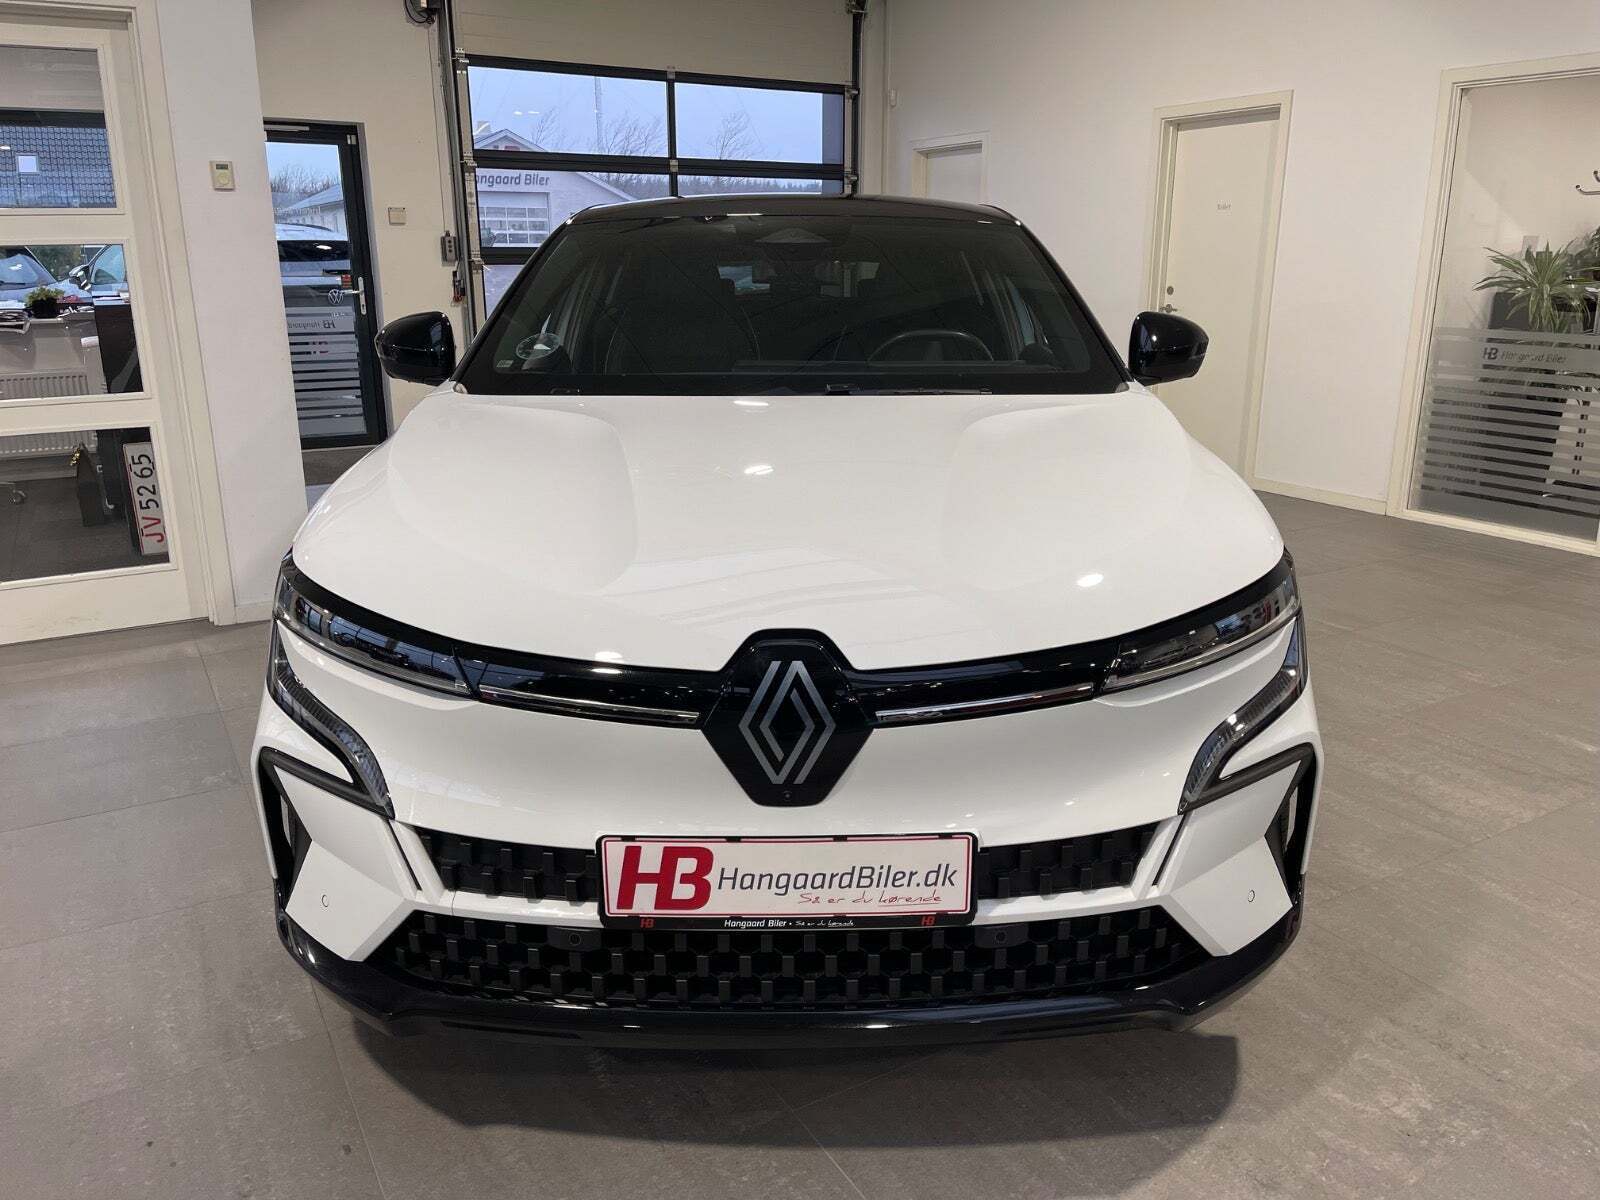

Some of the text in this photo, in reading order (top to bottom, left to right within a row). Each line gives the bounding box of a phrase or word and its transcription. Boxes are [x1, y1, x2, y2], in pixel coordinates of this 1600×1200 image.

[524, 172, 550, 186] Biler
[1483, 347, 1499, 360] HB
[141, 516, 165, 543] JV
[616, 845, 715, 911] HB
[717, 863, 957, 896] HangaardBiler.dk
[640, 918, 655, 928] HB
[724, 919, 765, 929] Hangaard
[767, 919, 788, 927] Biler
[921, 916, 936, 926] HB
